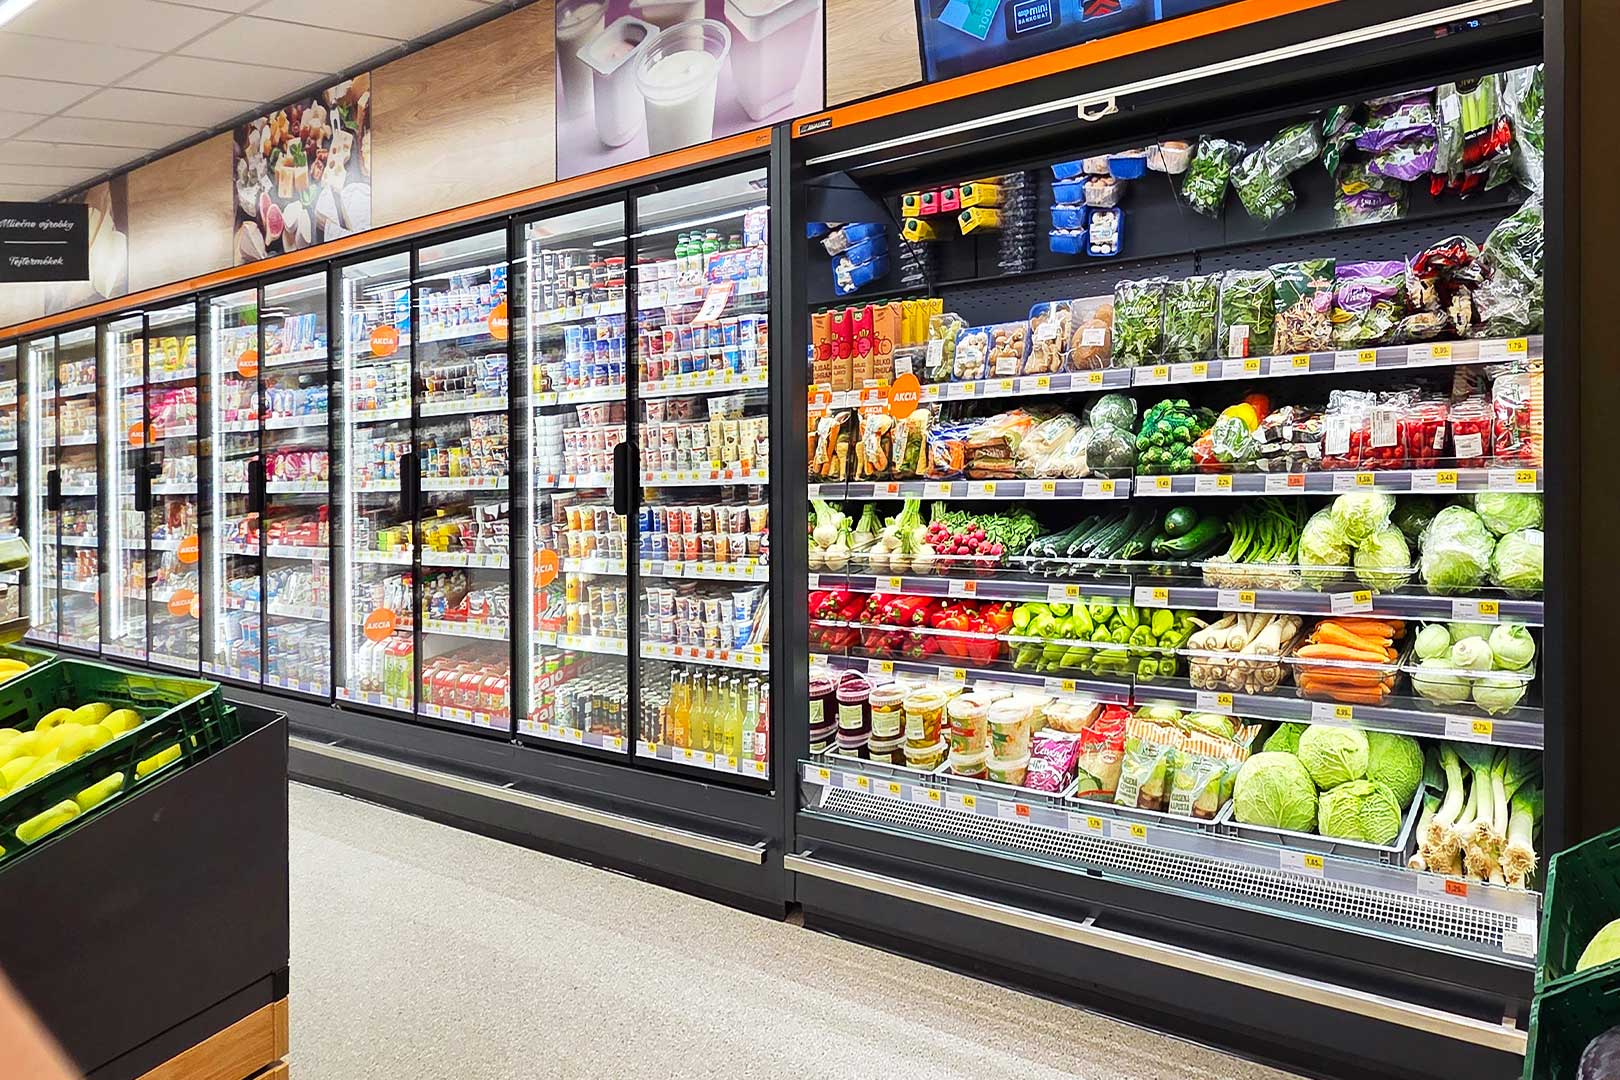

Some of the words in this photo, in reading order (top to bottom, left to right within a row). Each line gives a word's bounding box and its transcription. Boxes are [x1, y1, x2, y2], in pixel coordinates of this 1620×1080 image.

[1029, 3, 1049, 16] mini
[373, 338, 394, 346] AKCIA
[894, 391, 918, 402] AKCIA
[367, 621, 391, 630] AKCIA
